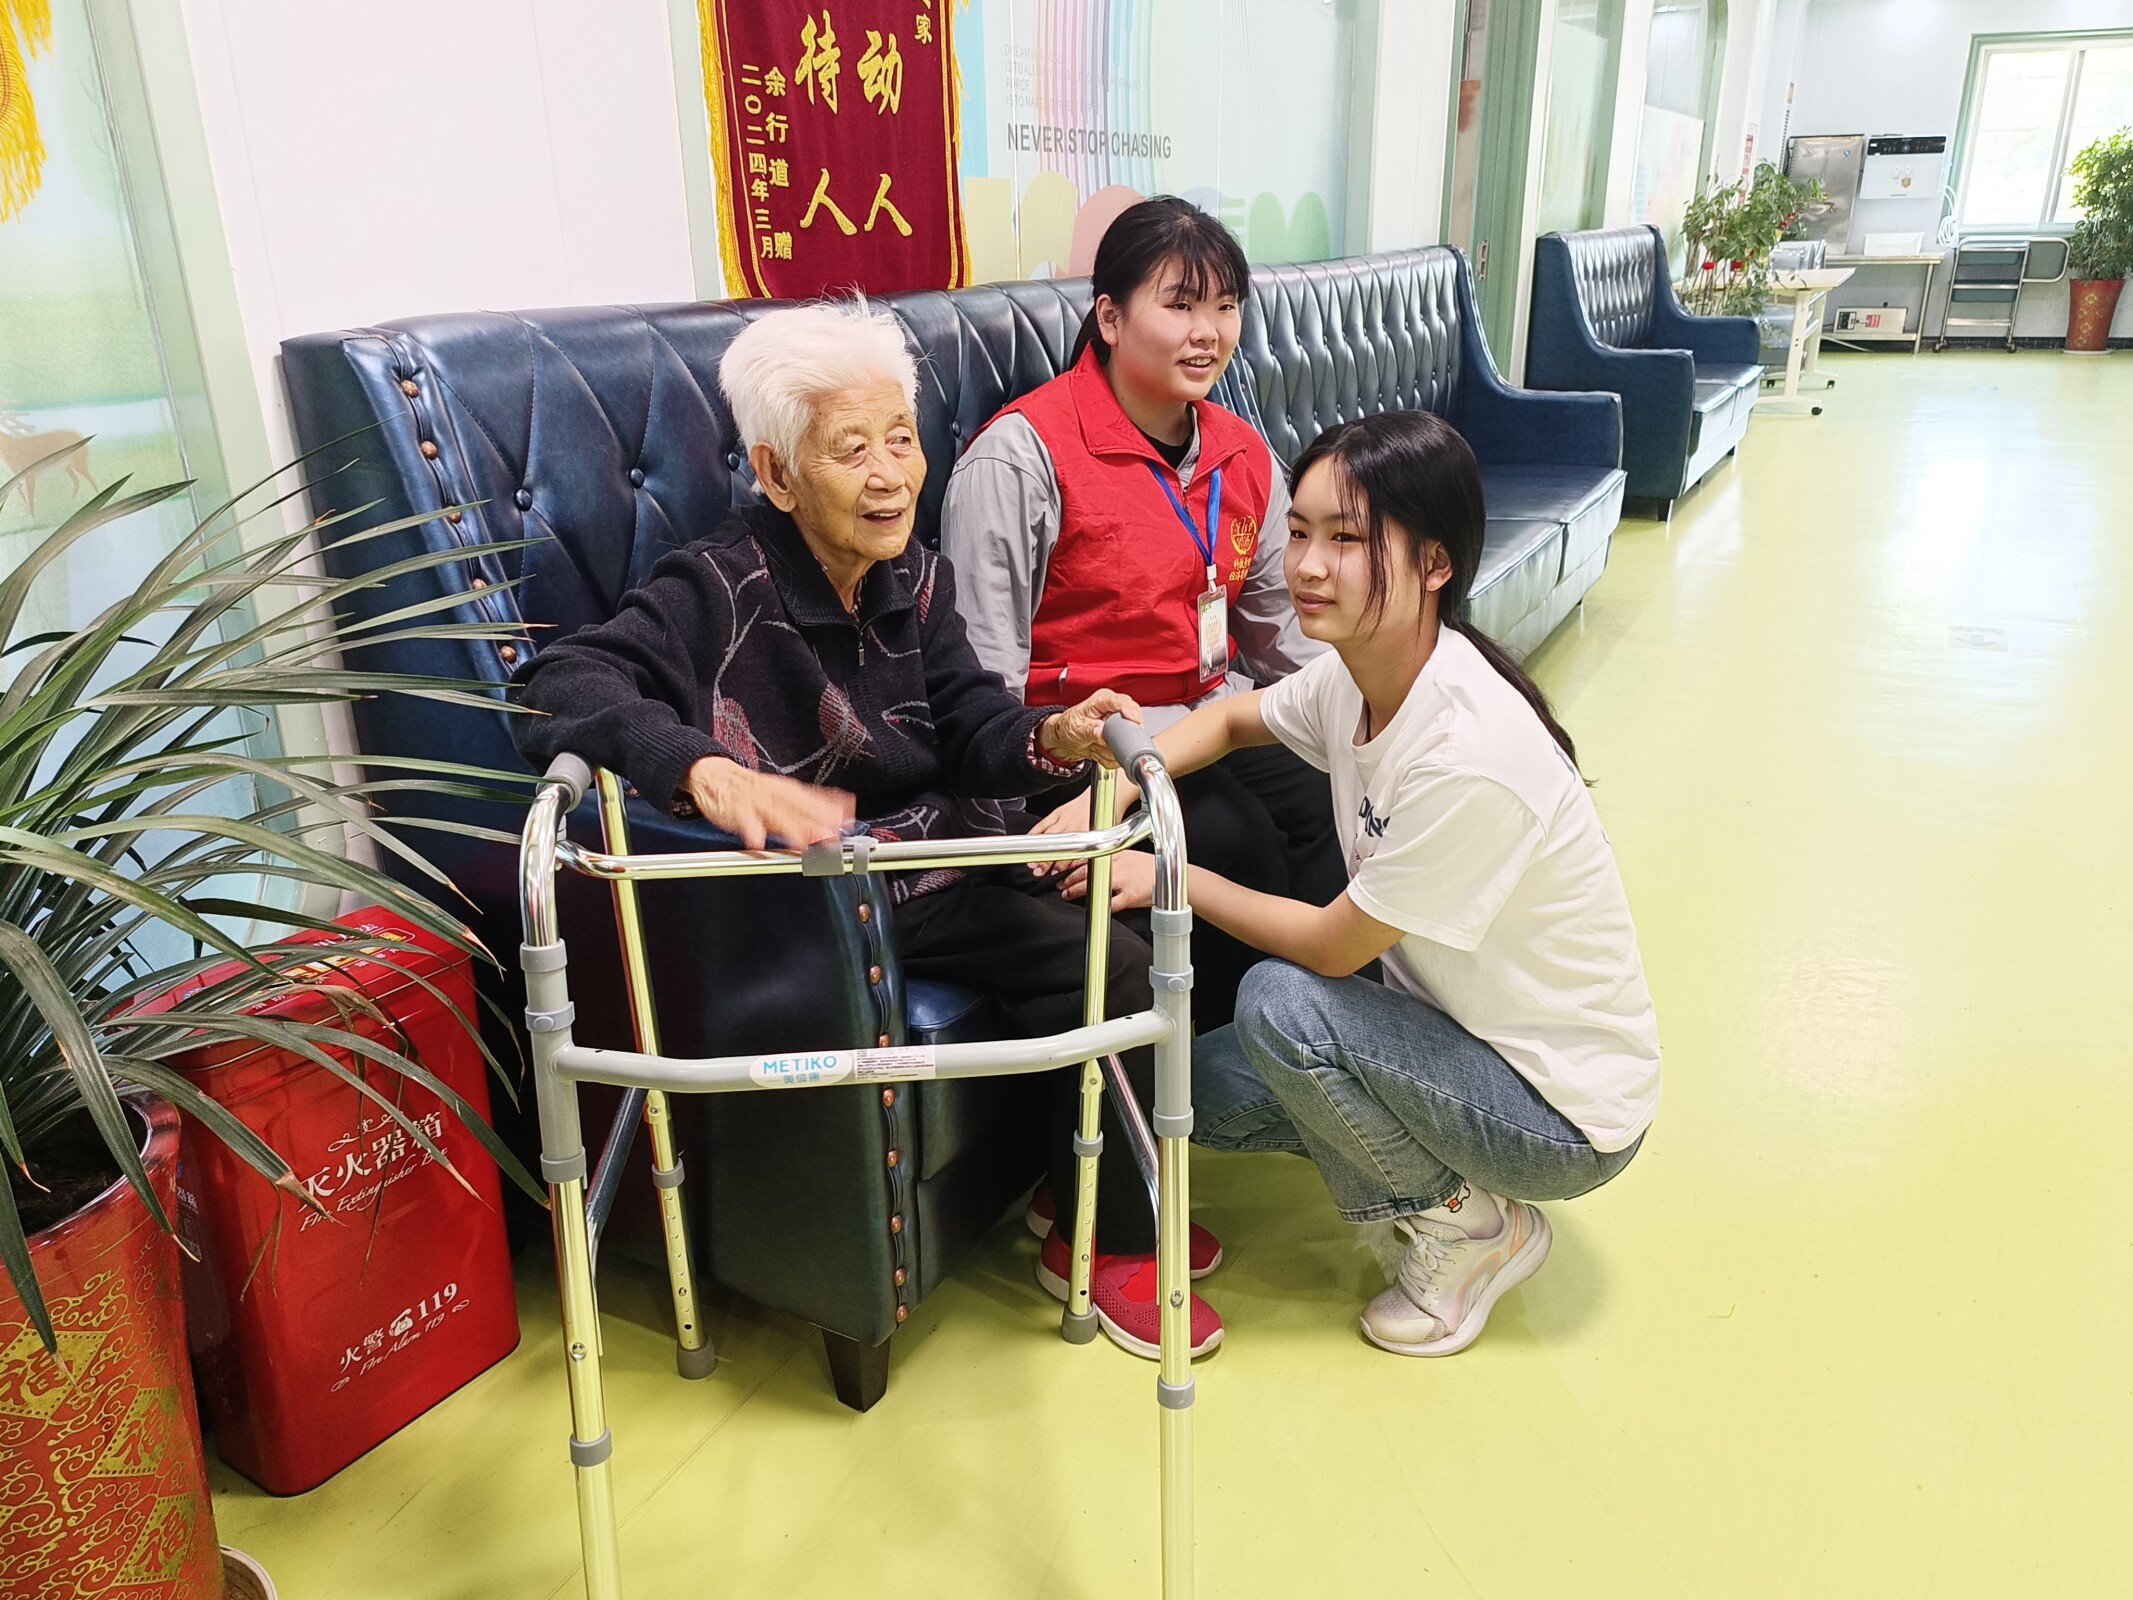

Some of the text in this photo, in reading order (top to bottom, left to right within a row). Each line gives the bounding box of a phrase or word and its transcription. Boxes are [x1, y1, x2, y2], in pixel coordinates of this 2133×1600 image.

[915, 0, 934, 45] 家
[794, 9, 858, 236] 待人
[857, 29, 914, 237] 动人
[1007, 123, 1172, 159] NEVER STOP CHASING
[763, 66, 793, 260] 余行道赠
[763, 1055, 837, 1074] METIKO
[336, 1153, 417, 1212] Extinguisher
[340, 1282, 458, 1375] 火警 119
[384, 1330, 421, 1360] Alarm
[425, 1312, 445, 1333] 119
